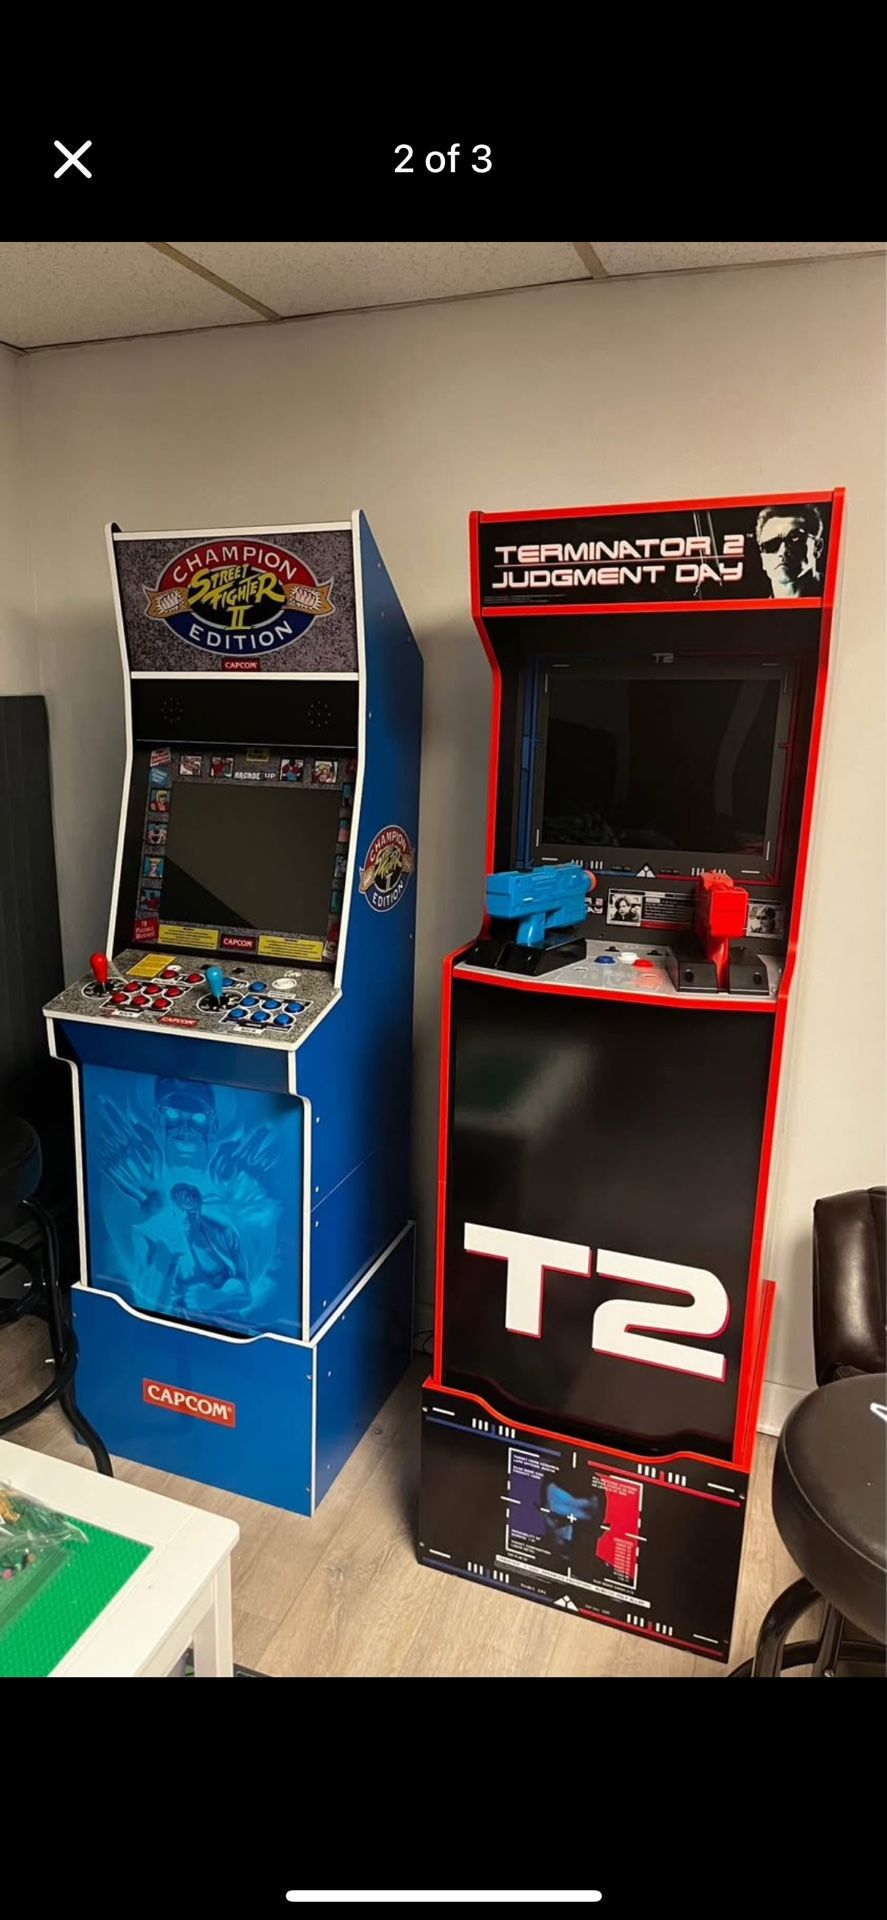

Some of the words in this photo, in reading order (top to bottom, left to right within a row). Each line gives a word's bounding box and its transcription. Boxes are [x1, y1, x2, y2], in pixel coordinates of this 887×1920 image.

[494, 536, 711, 563] TERMINATOR
[723, 534, 745, 555] 2
[173, 546, 298, 583] CHAMPION
[492, 565, 665, 589] JUDGMENT
[675, 562, 743, 584] DAY
[187, 563, 250, 606] STREET
[201, 571, 286, 610] FIGHTER
[225, 605, 253, 631] II
[189, 620, 293, 650] EDITION
[224, 661, 258, 670] CAPCOM
[652, 652, 675, 664] T2
[369, 830, 407, 862] CHAMPION
[372, 879, 404, 907] EDITION
[223, 937, 253, 947] CAPCOM
[463, 1222, 731, 1383] T2
[147, 1384, 229, 1420] CAPCOM
